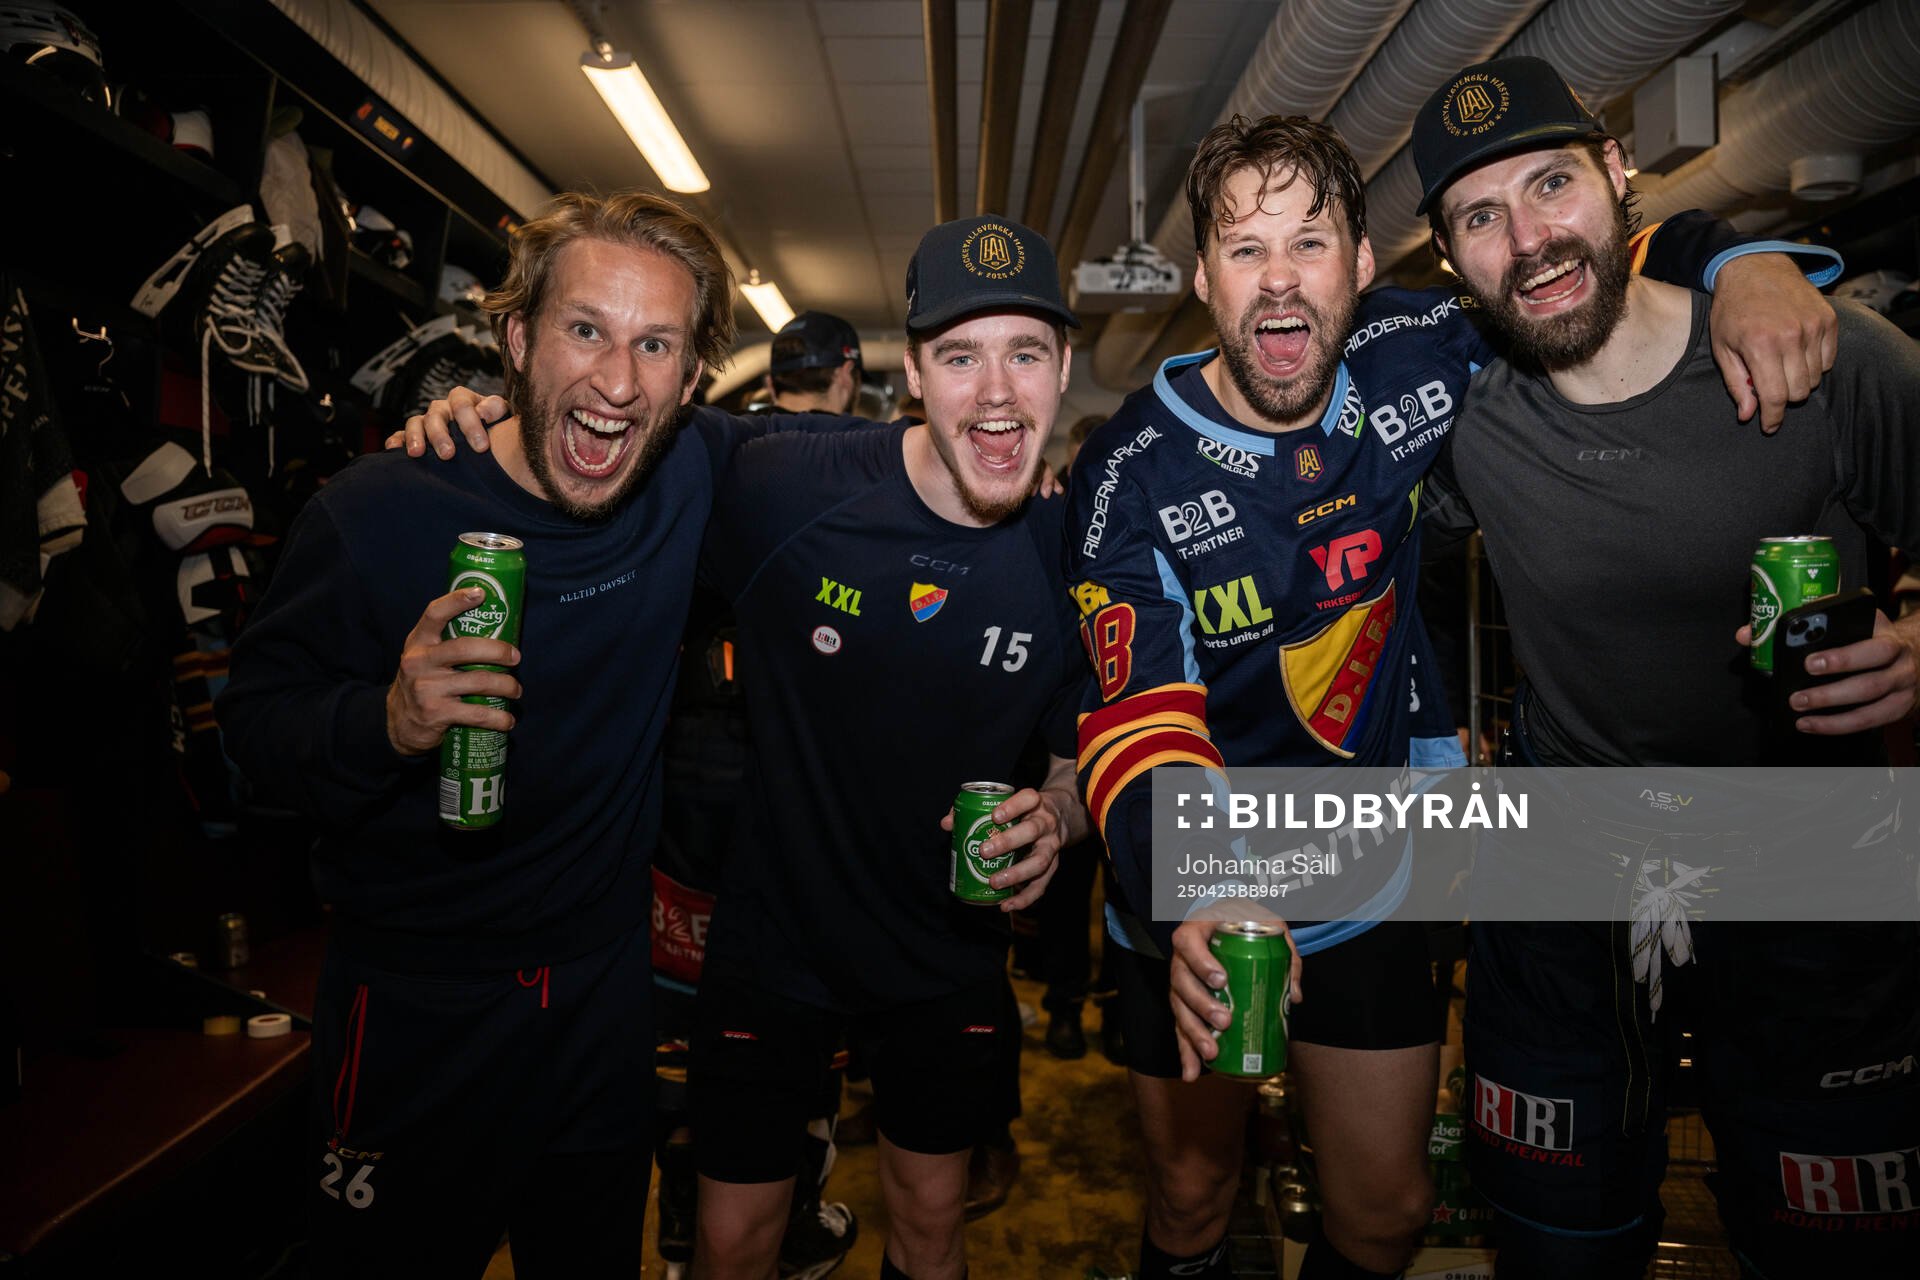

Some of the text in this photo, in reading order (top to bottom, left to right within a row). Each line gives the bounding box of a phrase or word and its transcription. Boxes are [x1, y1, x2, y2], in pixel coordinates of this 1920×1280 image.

[1369, 380, 1453, 446] B2B
[1197, 437, 1262, 473] RYDS
[1578, 447, 1642, 461] CCM
[1220, 462, 1256, 479] BILGLAS
[1158, 489, 1236, 544] B2B
[1297, 494, 1357, 525] CCM
[466, 553, 495, 565] ORGANIC
[909, 553, 972, 576] CCM
[1308, 528, 1384, 592] YP
[559, 568, 637, 603] ALLTID OAVSETT
[815, 576, 863, 617] XXL
[460, 621, 486, 635] Hof
[1202, 622, 1275, 649] orts unite all
[979, 625, 1033, 673] 15
[1640, 788, 1694, 806] AS-V
[1650, 801, 1680, 812] PRO
[981, 859, 1001, 869] Hof
[1819, 1054, 1919, 1089] CCM
[1503, 1141, 1585, 1168] RENTAL
[319, 1152, 376, 1209] 26
